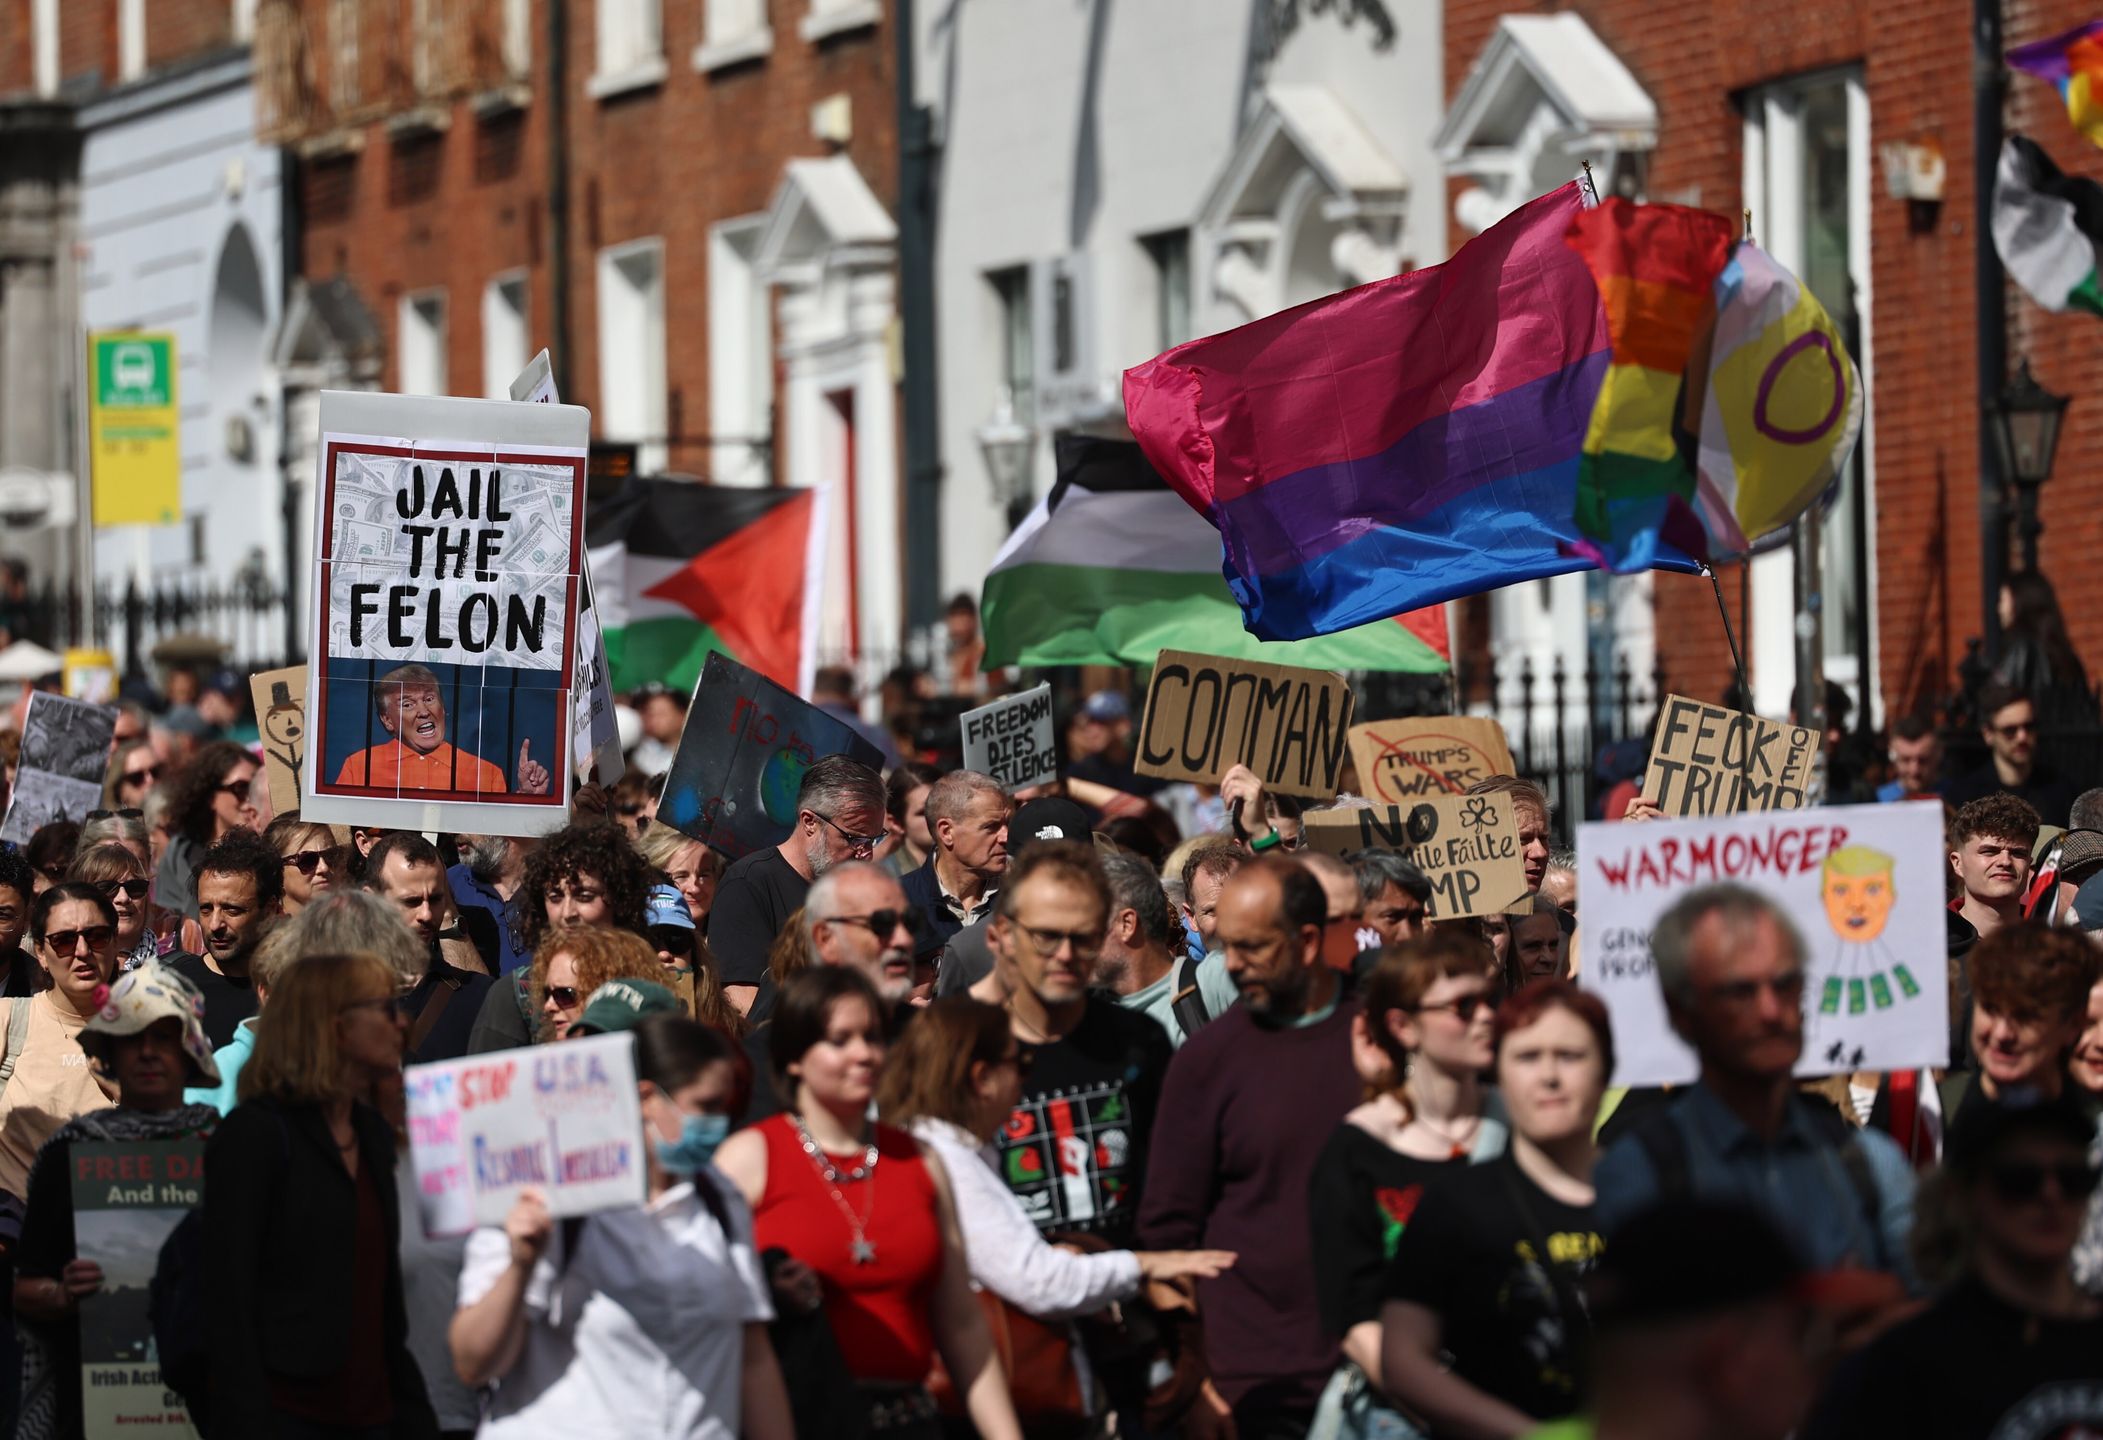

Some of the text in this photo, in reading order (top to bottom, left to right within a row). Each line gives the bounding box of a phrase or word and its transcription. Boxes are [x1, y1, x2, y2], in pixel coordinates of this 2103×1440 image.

[396, 465, 511, 522] JAIL
[401, 525, 504, 582] THE
[350, 584, 546, 653] FELON
[968, 694, 1050, 745] FREEDOM
[1660, 700, 1781, 778] FECK
[987, 727, 1035, 766] DIES
[1381, 745, 1471, 769] TRUMP'S
[1391, 768, 1481, 796] WARS
[1653, 757, 1803, 820] TRUMP
[1359, 802, 1438, 848] NO
[1446, 834, 1516, 866] Fáilte
[1597, 826, 1849, 893] WARMONGER
[534, 1052, 608, 1093] USA
[78, 1154, 206, 1181] FREE DA
[107, 1183, 199, 1204] And the
[91, 1369, 129, 1387] Irish
